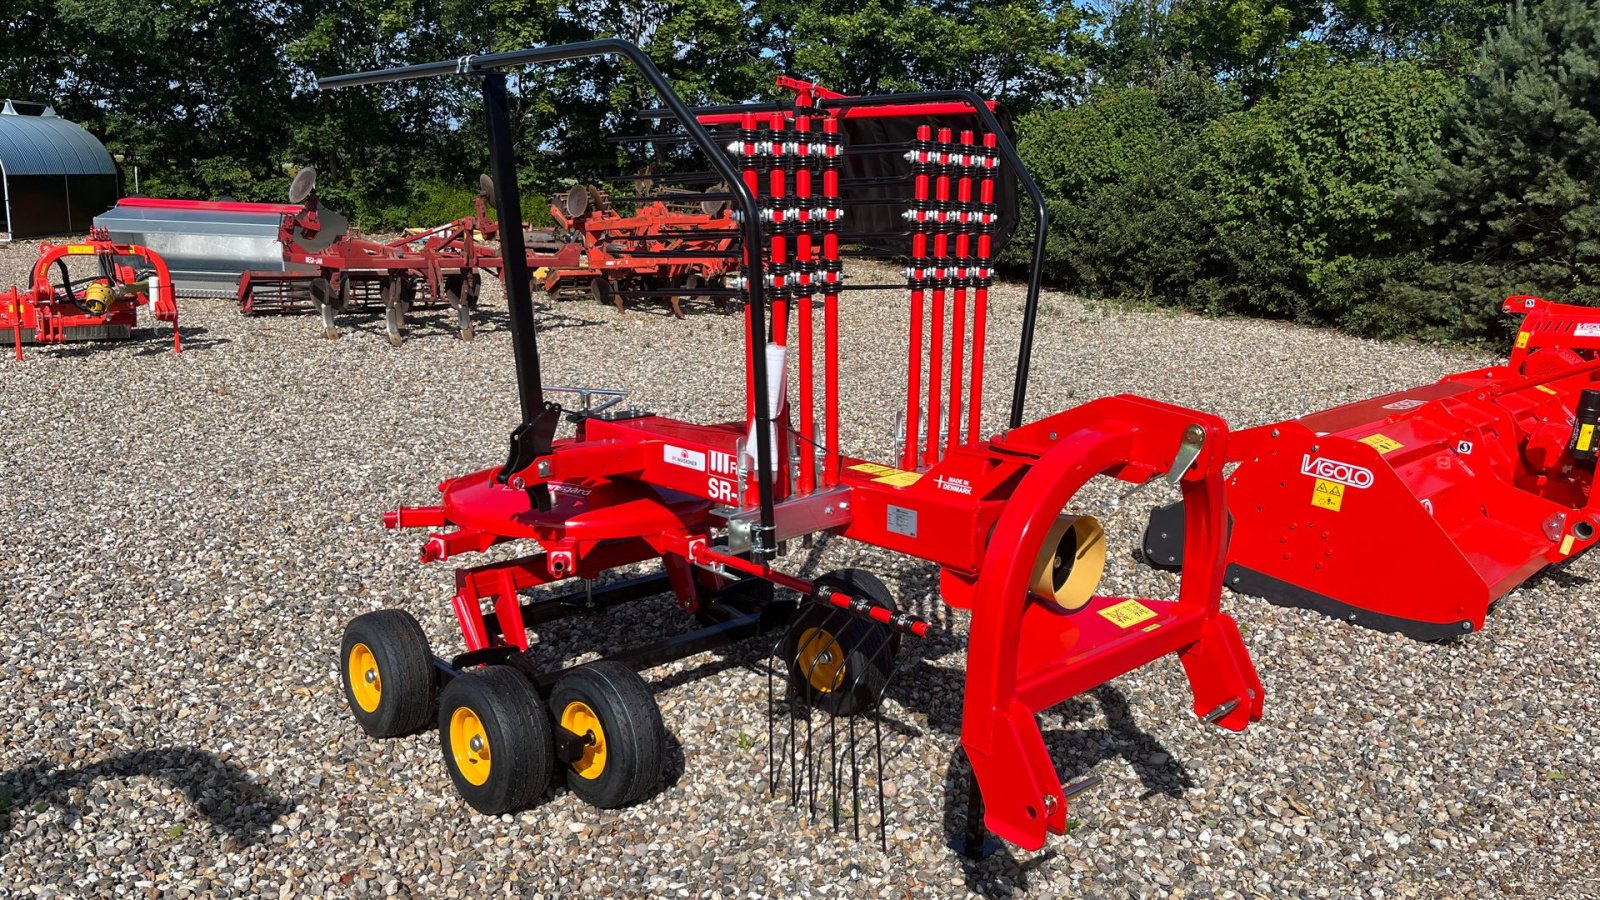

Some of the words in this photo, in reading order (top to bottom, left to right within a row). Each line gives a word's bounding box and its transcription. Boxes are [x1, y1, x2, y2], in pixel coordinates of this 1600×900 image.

[1300, 453, 1374, 489] VIGOLO
[948, 476, 963, 484] MADE
[942, 483, 971, 495] DENMARK
